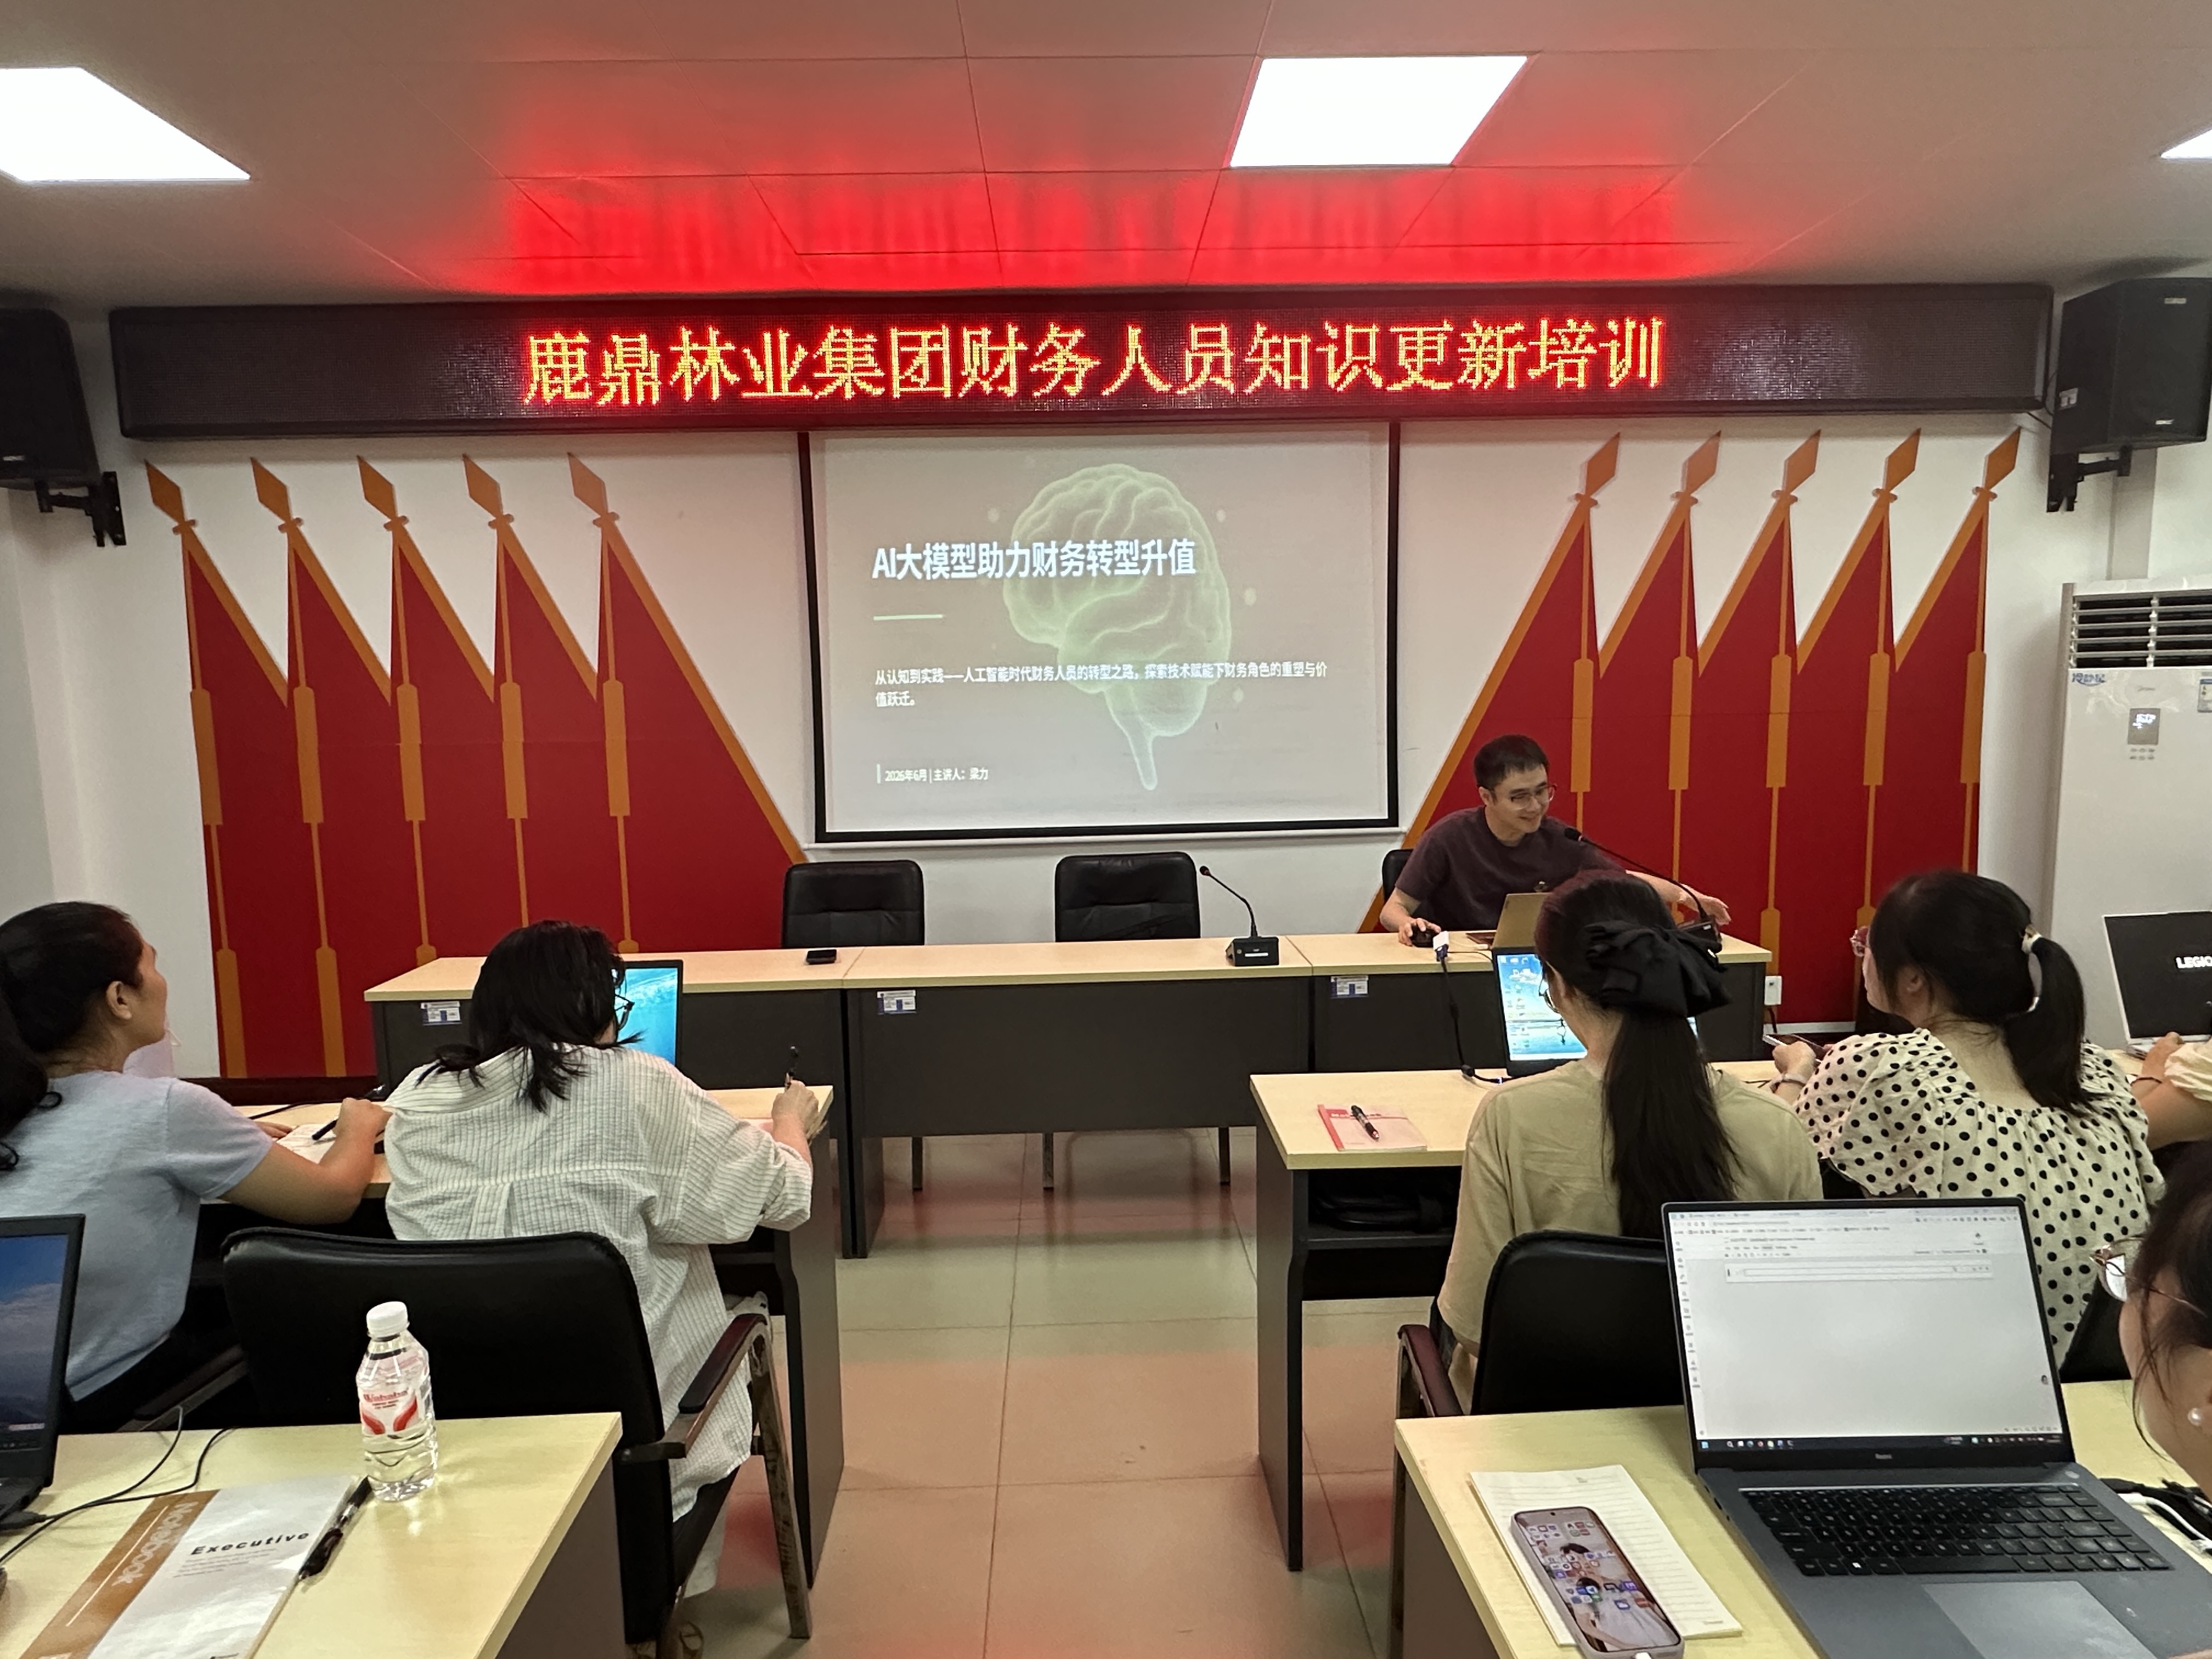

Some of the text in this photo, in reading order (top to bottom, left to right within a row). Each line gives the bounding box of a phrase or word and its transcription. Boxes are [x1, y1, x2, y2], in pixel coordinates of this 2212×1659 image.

[523, 317, 1664, 406] 鹿鼎林业集团财务人员知识更新培训
[872, 538, 1197, 580] AI大模型助力财务转型升值
[191, 1533, 309, 1555] Executive
